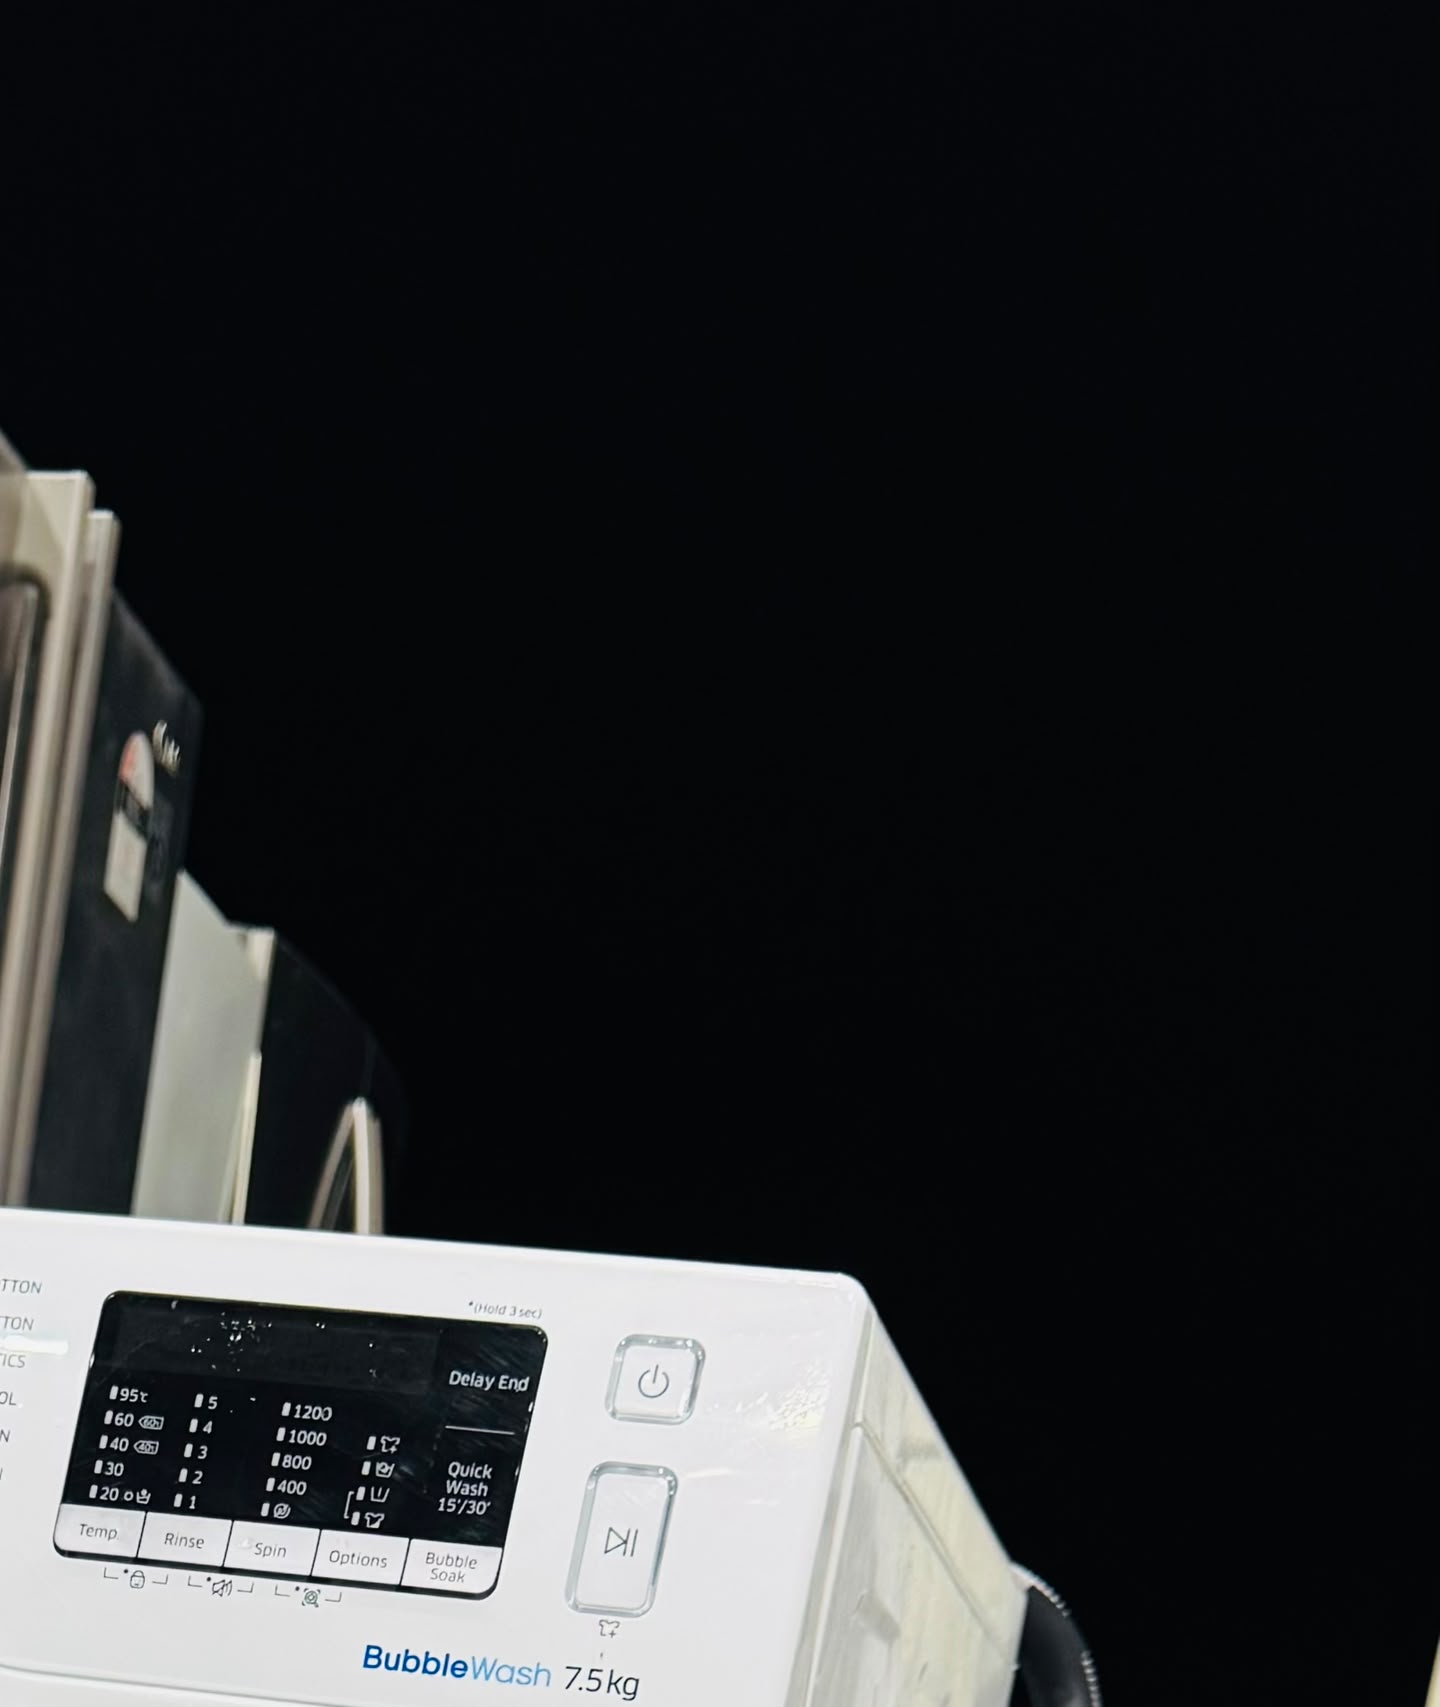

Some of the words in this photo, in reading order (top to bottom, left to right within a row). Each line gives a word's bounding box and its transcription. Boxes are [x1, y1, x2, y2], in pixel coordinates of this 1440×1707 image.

[449, 1370, 495, 1391] Delay
[498, 1375, 530, 1392] End
[208, 1396, 218, 1409] 5
[115, 1413, 134, 1427] 60
[294, 1404, 333, 1421] 1200
[203, 1420, 213, 1434] 4
[110, 1438, 129, 1452] 40
[289, 1429, 327, 1446] 1000
[197, 1445, 208, 1459] 3
[104, 1461, 124, 1477] 30
[282, 1454, 312, 1470] 800
[448, 1461, 492, 1479] Quick
[192, 1470, 203, 1484] 2
[99, 1486, 119, 1501] 20
[277, 1479, 307, 1495] 400
[446, 1480, 488, 1496] Wash
[189, 1495, 196, 1509] 1
[164, 1532, 205, 1549] Rinse
[254, 1542, 287, 1558] Spin
[329, 1550, 388, 1568] Options
[425, 1552, 478, 1570] Bubble
[430, 1568, 465, 1583] Soak
